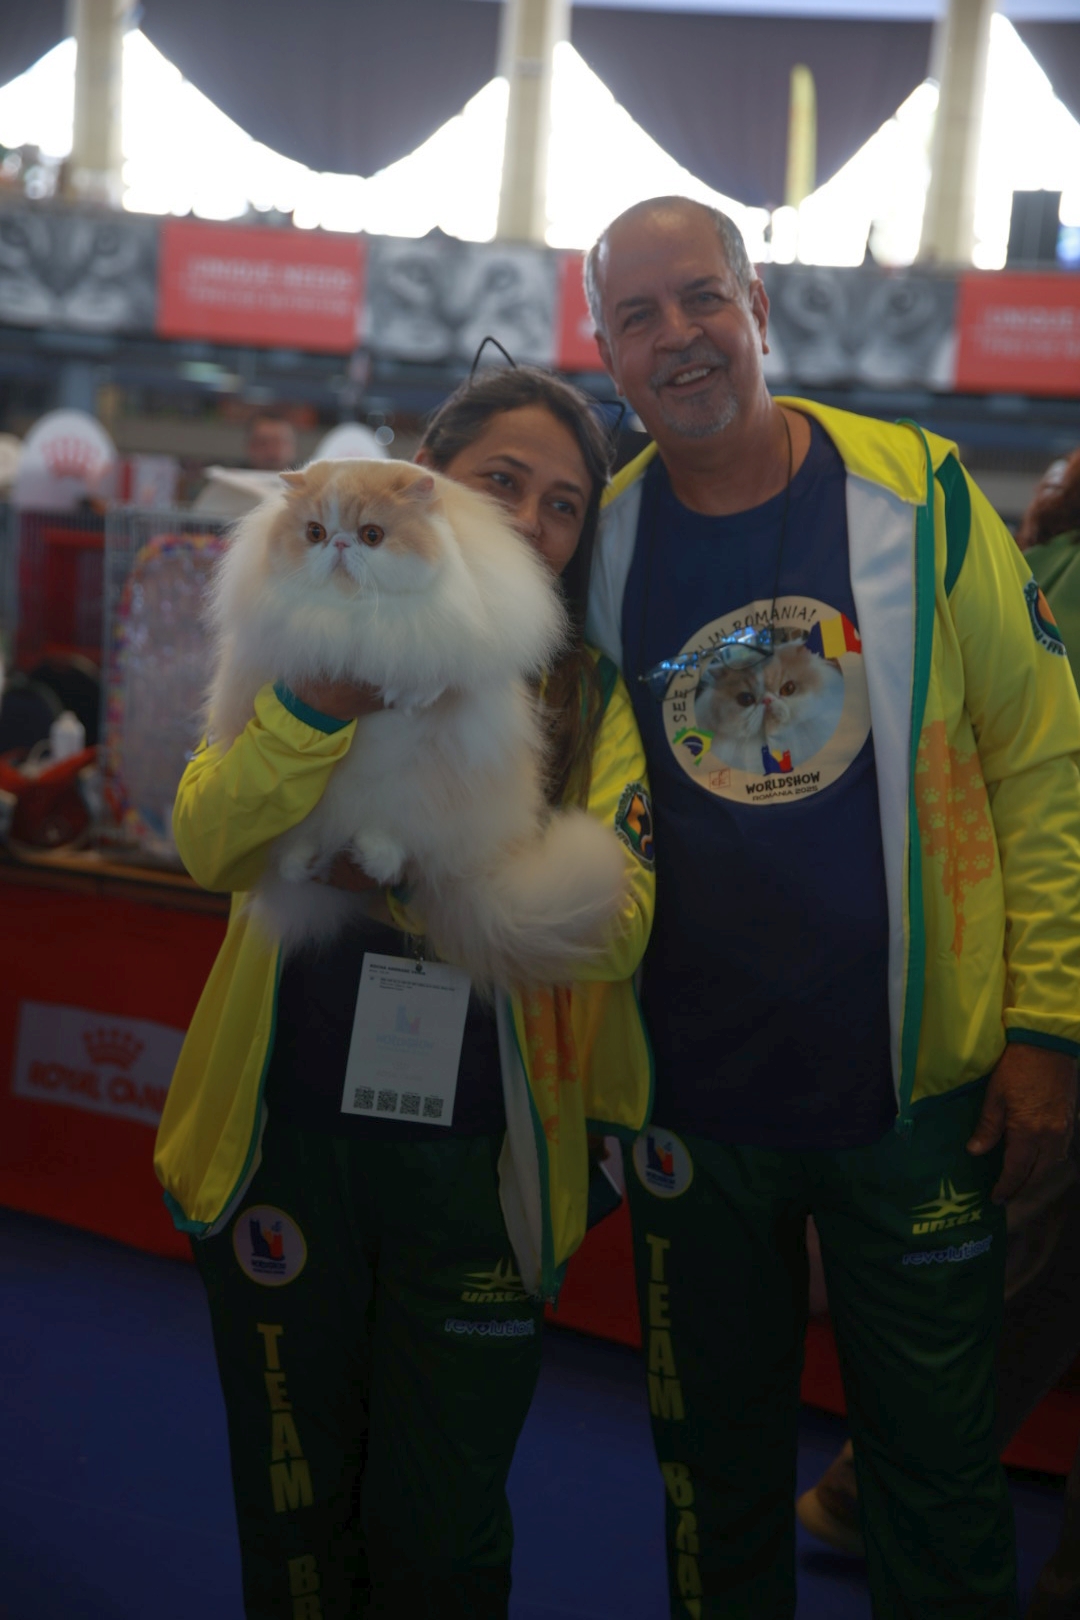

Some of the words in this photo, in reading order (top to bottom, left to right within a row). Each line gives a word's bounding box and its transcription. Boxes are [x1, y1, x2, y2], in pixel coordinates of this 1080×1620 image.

[673, 688, 689, 723] SEE
[732, 605, 817, 632] ROMANIA!
[745, 771, 820, 795] WORLDSHOW
[752, 790, 794, 801] ROMANIA
[443, 1318, 535, 1337] revolution
[645, 1233, 686, 1421] TEAM
[256, 1322, 316, 1513] TEAM
